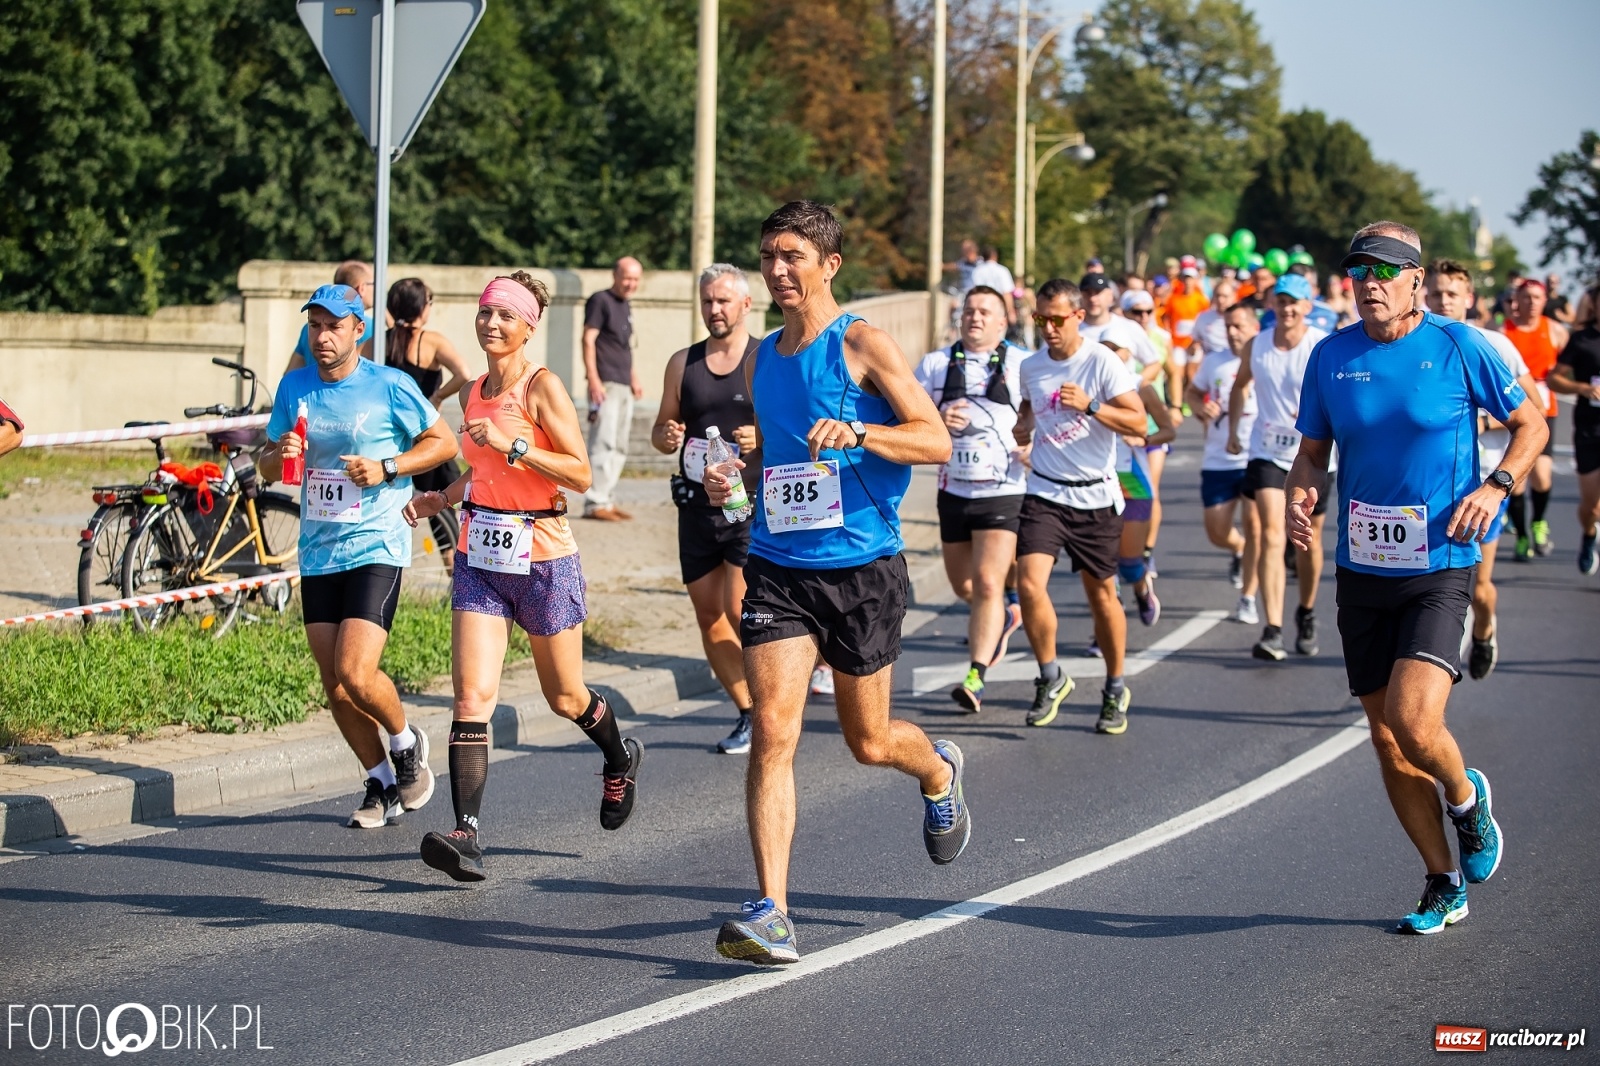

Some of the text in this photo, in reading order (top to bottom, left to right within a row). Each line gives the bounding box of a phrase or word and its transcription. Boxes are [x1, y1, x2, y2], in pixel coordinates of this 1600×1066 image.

[958, 450, 980, 464] 116
[320, 484, 343, 502] 161
[782, 480, 819, 505] 385
[482, 528, 513, 549] 258
[1368, 522, 1406, 544] 310
